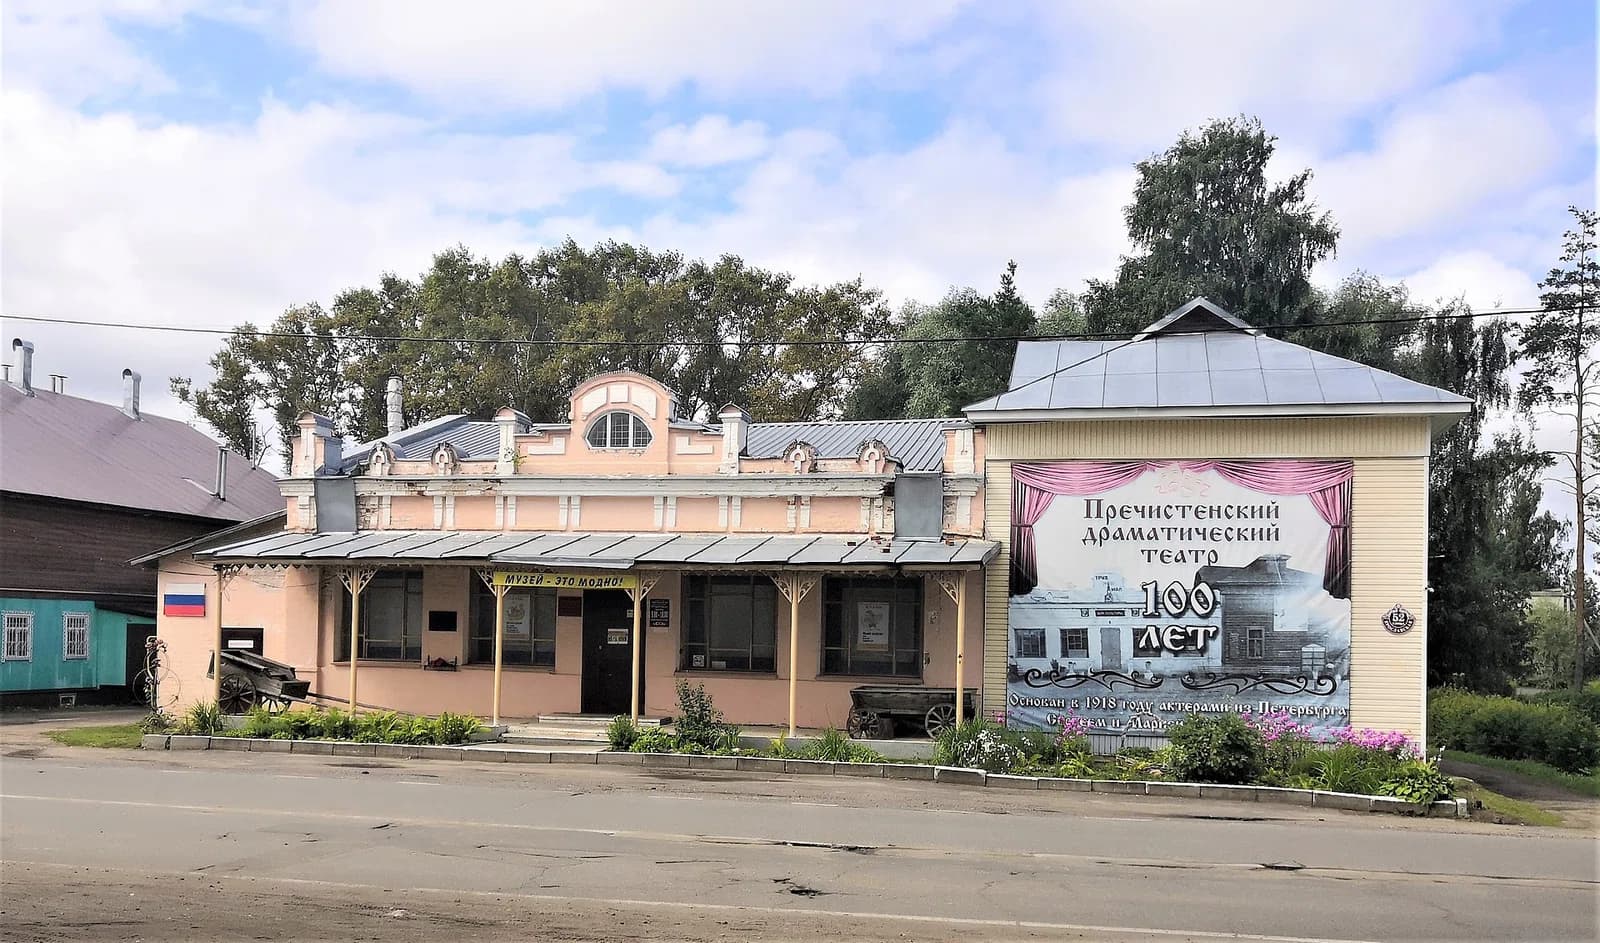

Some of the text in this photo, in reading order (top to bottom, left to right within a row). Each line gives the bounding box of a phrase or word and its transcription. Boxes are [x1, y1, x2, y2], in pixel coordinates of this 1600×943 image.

[1083, 498, 1281, 522] Пречистенский
[1081, 522, 1281, 546] драматический
[1140, 547, 1219, 567] театр
[505, 574, 544, 586] МУЗЕЙ
[555, 576, 575, 586] ЭТО
[577, 576, 623, 588] МОДНО!
[1142, 580, 1217, 617] 100
[1009, 694, 1347, 719] Основан в 1918 году актерами из Петербурга
